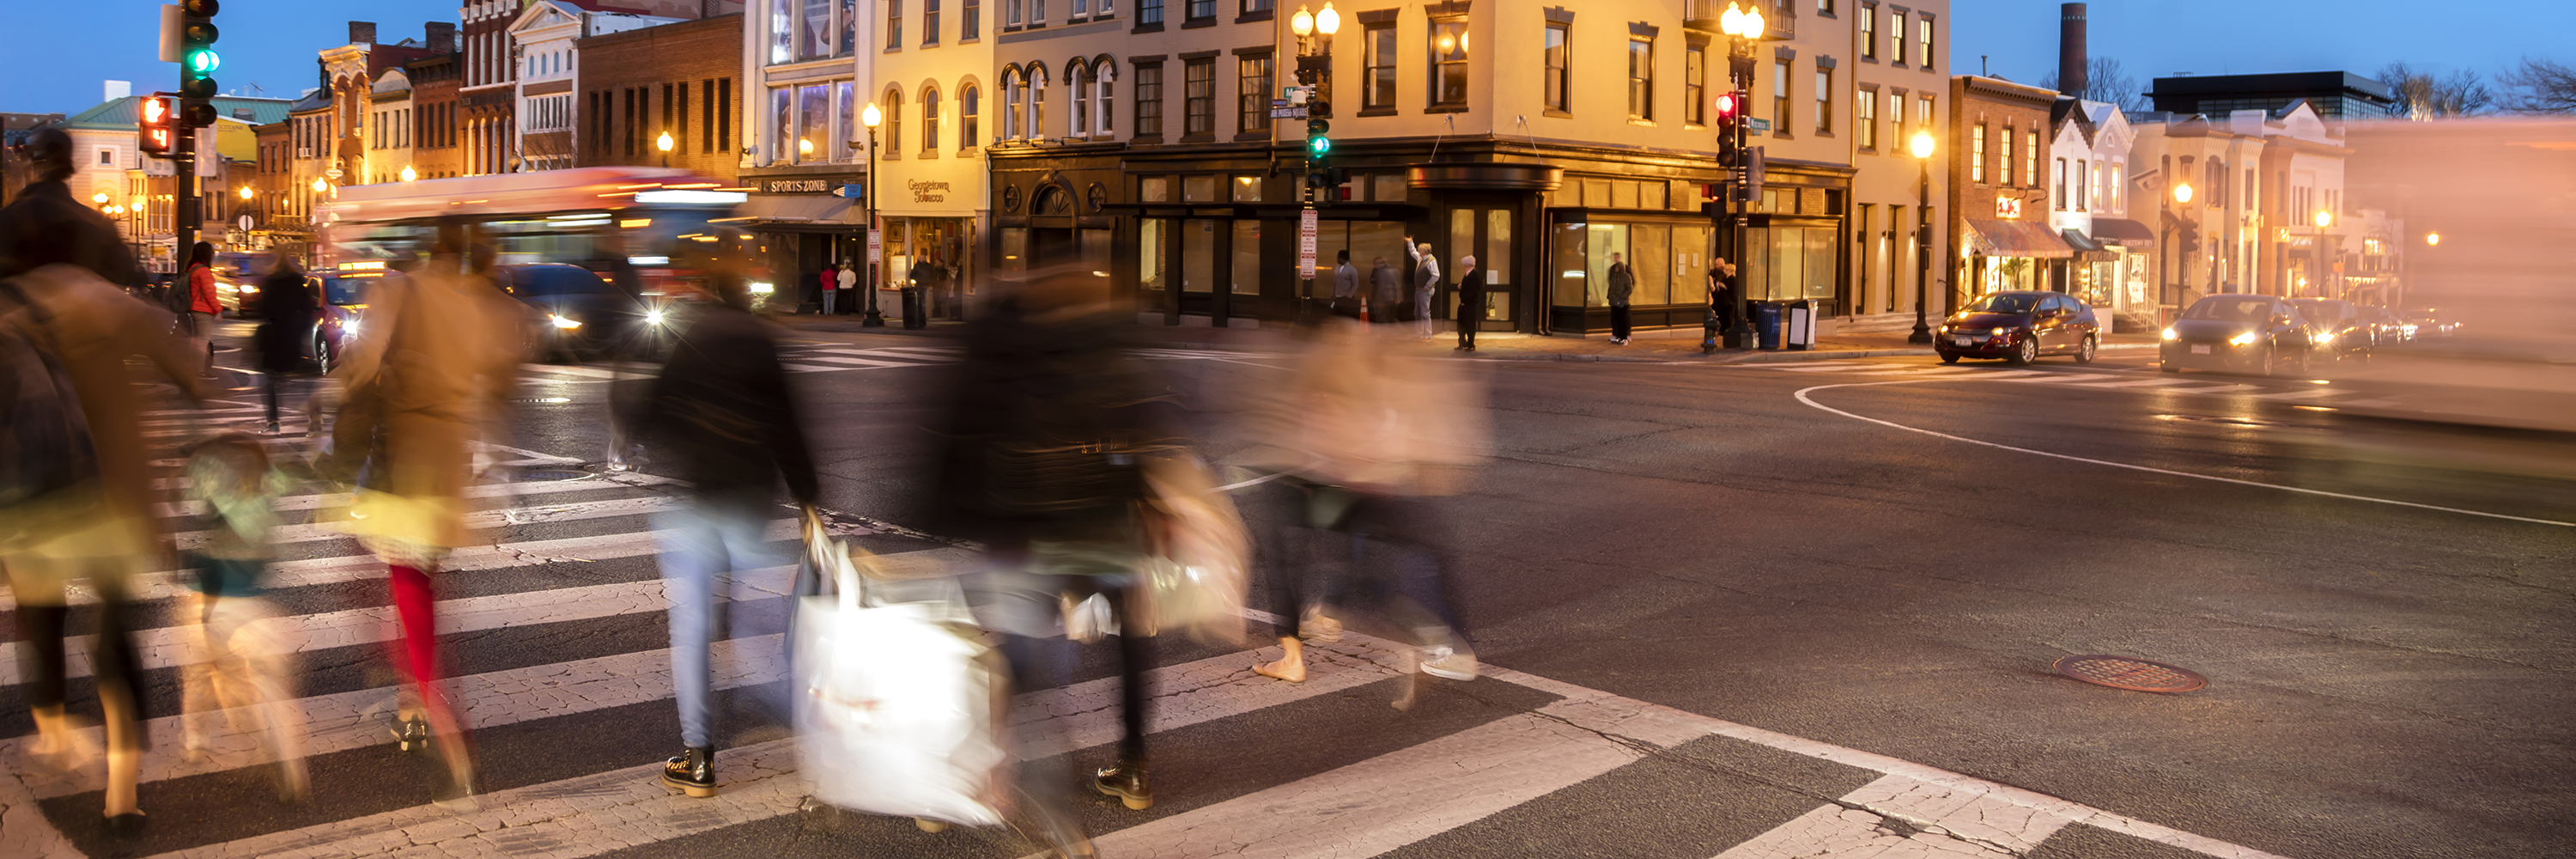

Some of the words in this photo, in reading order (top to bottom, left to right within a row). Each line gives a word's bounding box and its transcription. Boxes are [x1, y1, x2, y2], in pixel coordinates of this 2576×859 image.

[153, 130, 167, 147] 4
[771, 180, 803, 192] SPORTS
[803, 180, 825, 192] ZONE
[908, 179, 951, 192] Georgetown
[914, 190, 944, 203] Tobacco
